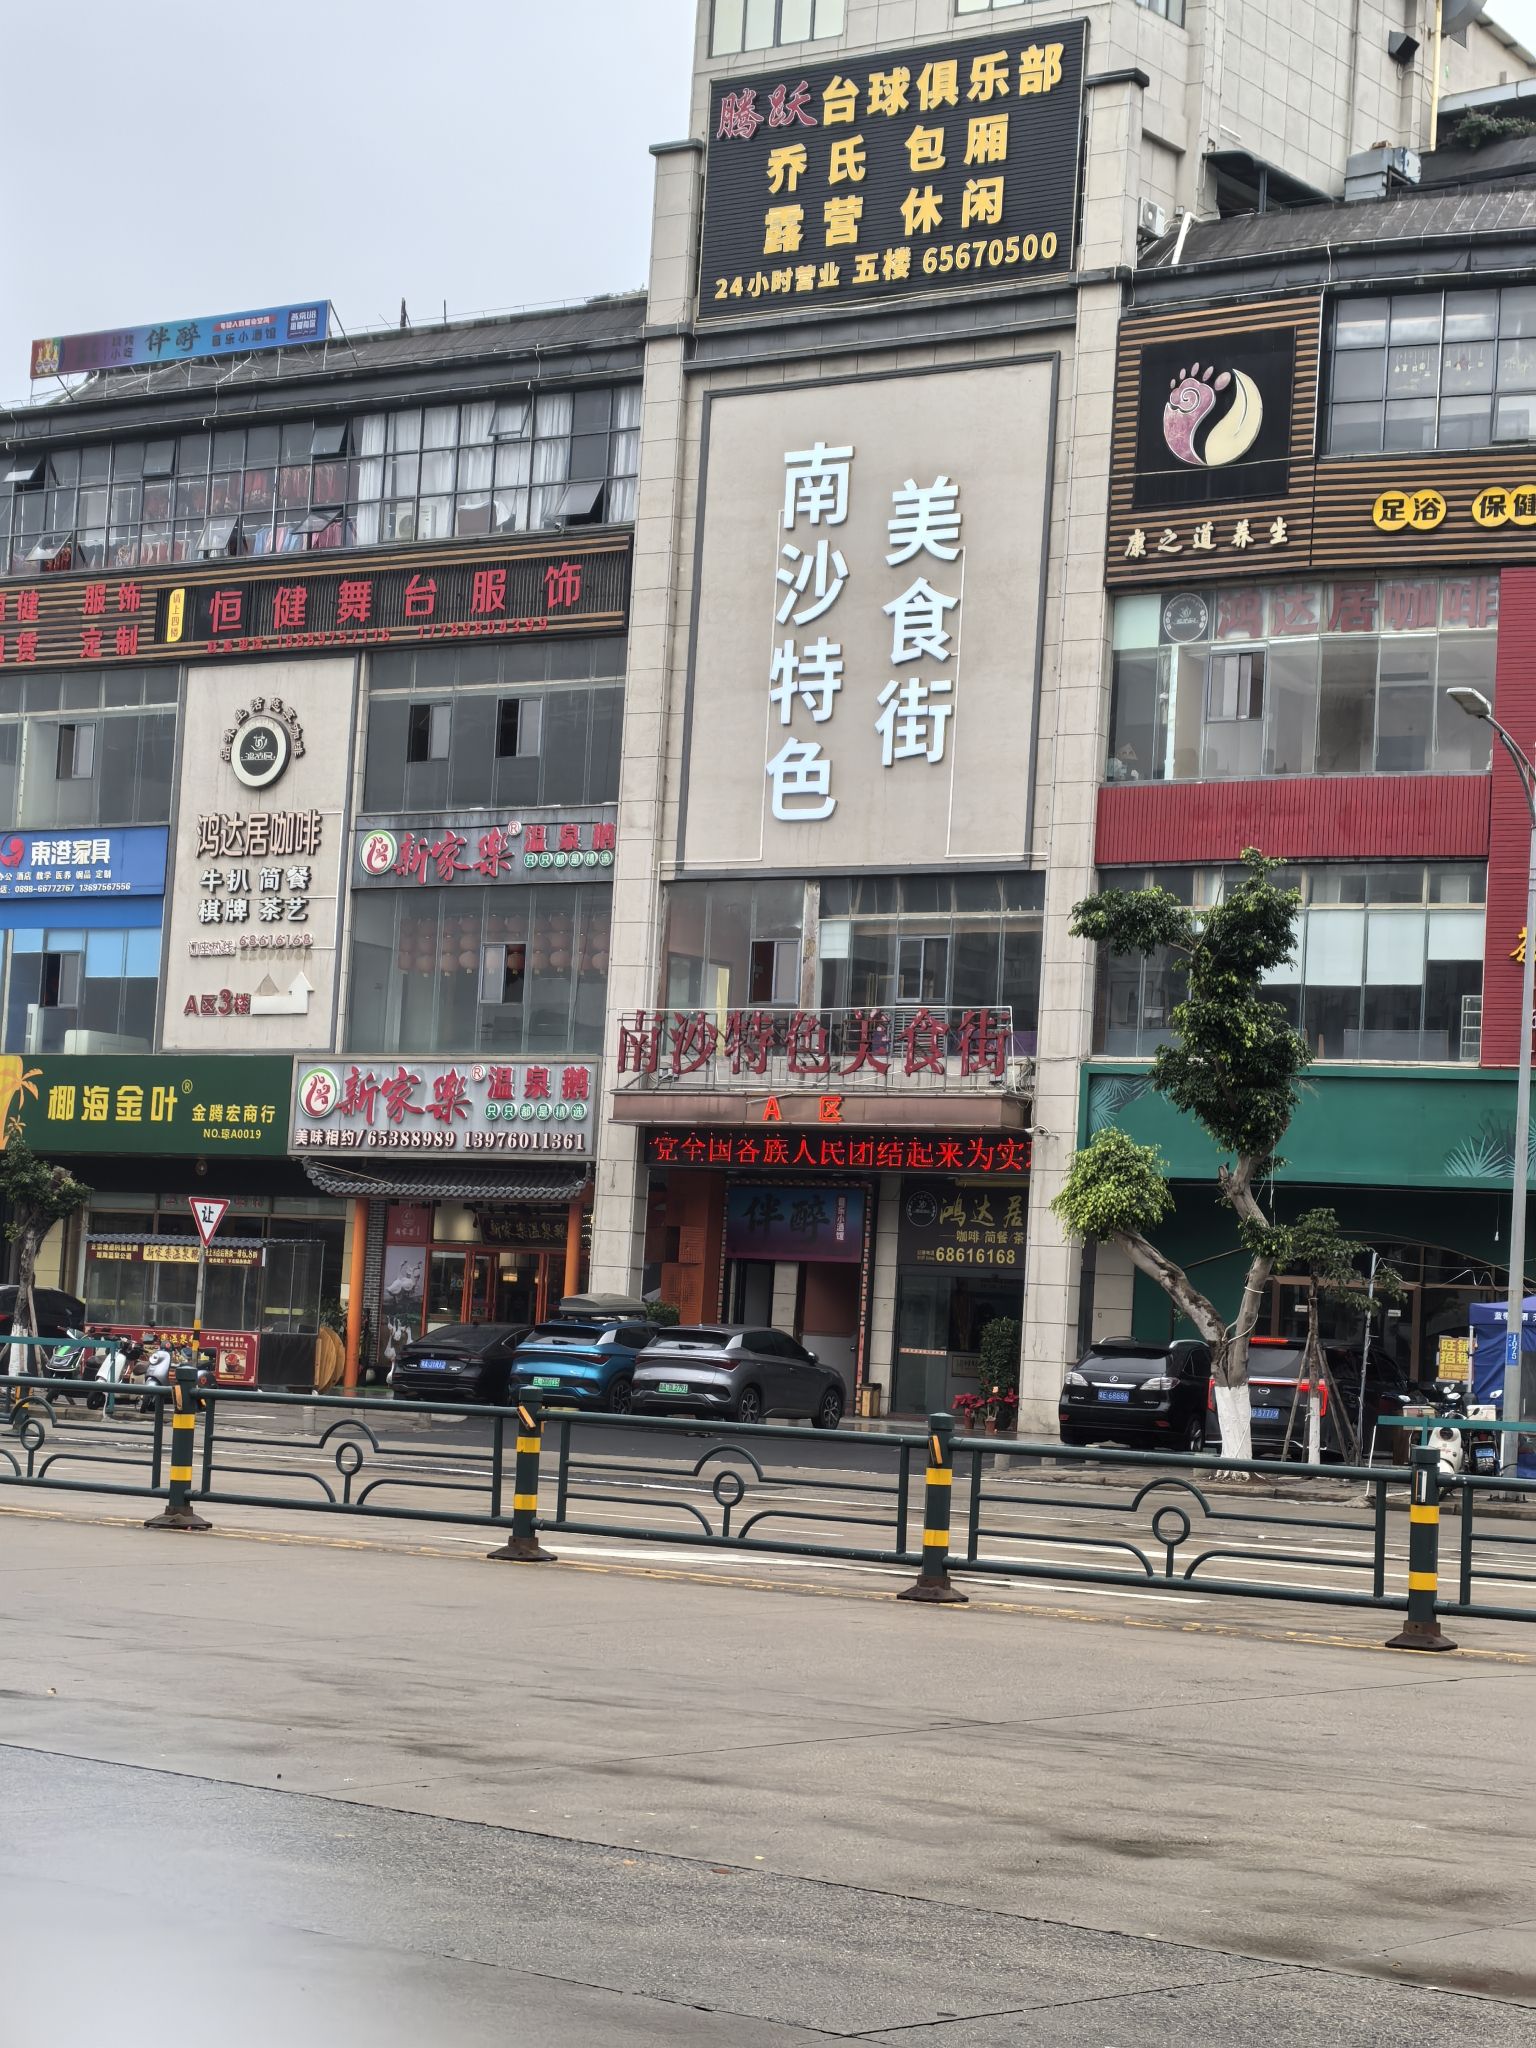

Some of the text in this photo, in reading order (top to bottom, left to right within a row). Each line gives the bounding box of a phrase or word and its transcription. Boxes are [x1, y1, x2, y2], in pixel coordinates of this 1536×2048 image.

[714, 232, 1058, 300] 24小时营业 五楼 65670500
[1379, 496, 1442, 523] 足浴
[1124, 516, 1290, 559] 康之道养生
[208, 561, 583, 633] 恒健舞台服饰
[1217, 576, 1498, 639] 鸿达居咖啡
[766, 441, 854, 821] 南沙特色
[875, 475, 964, 767] 美食街
[196, 809, 322, 859] 鸿达居咖啡
[199, 865, 311, 893] 牛扒 简餐
[198, 896, 309, 924] 棋牌 茶艺
[183, 989, 252, 1016] A区3楼
[617, 1009, 1011, 1077] 南沙特色美食街
[48, 1085, 178, 1122] 椰海金叶
[192, 1104, 275, 1124] 金腾宏商行
[485, 1103, 587, 1121] 只只都是精选
[464, 1131, 585, 1150] 13976011361
[653, 1131, 1031, 1172] 党全国各族人民团结起来为实
[202, 1205, 214, 1225] 让
[939, 1188, 1023, 1228] 鸿达居
[935, 1247, 1016, 1265] 68616168
